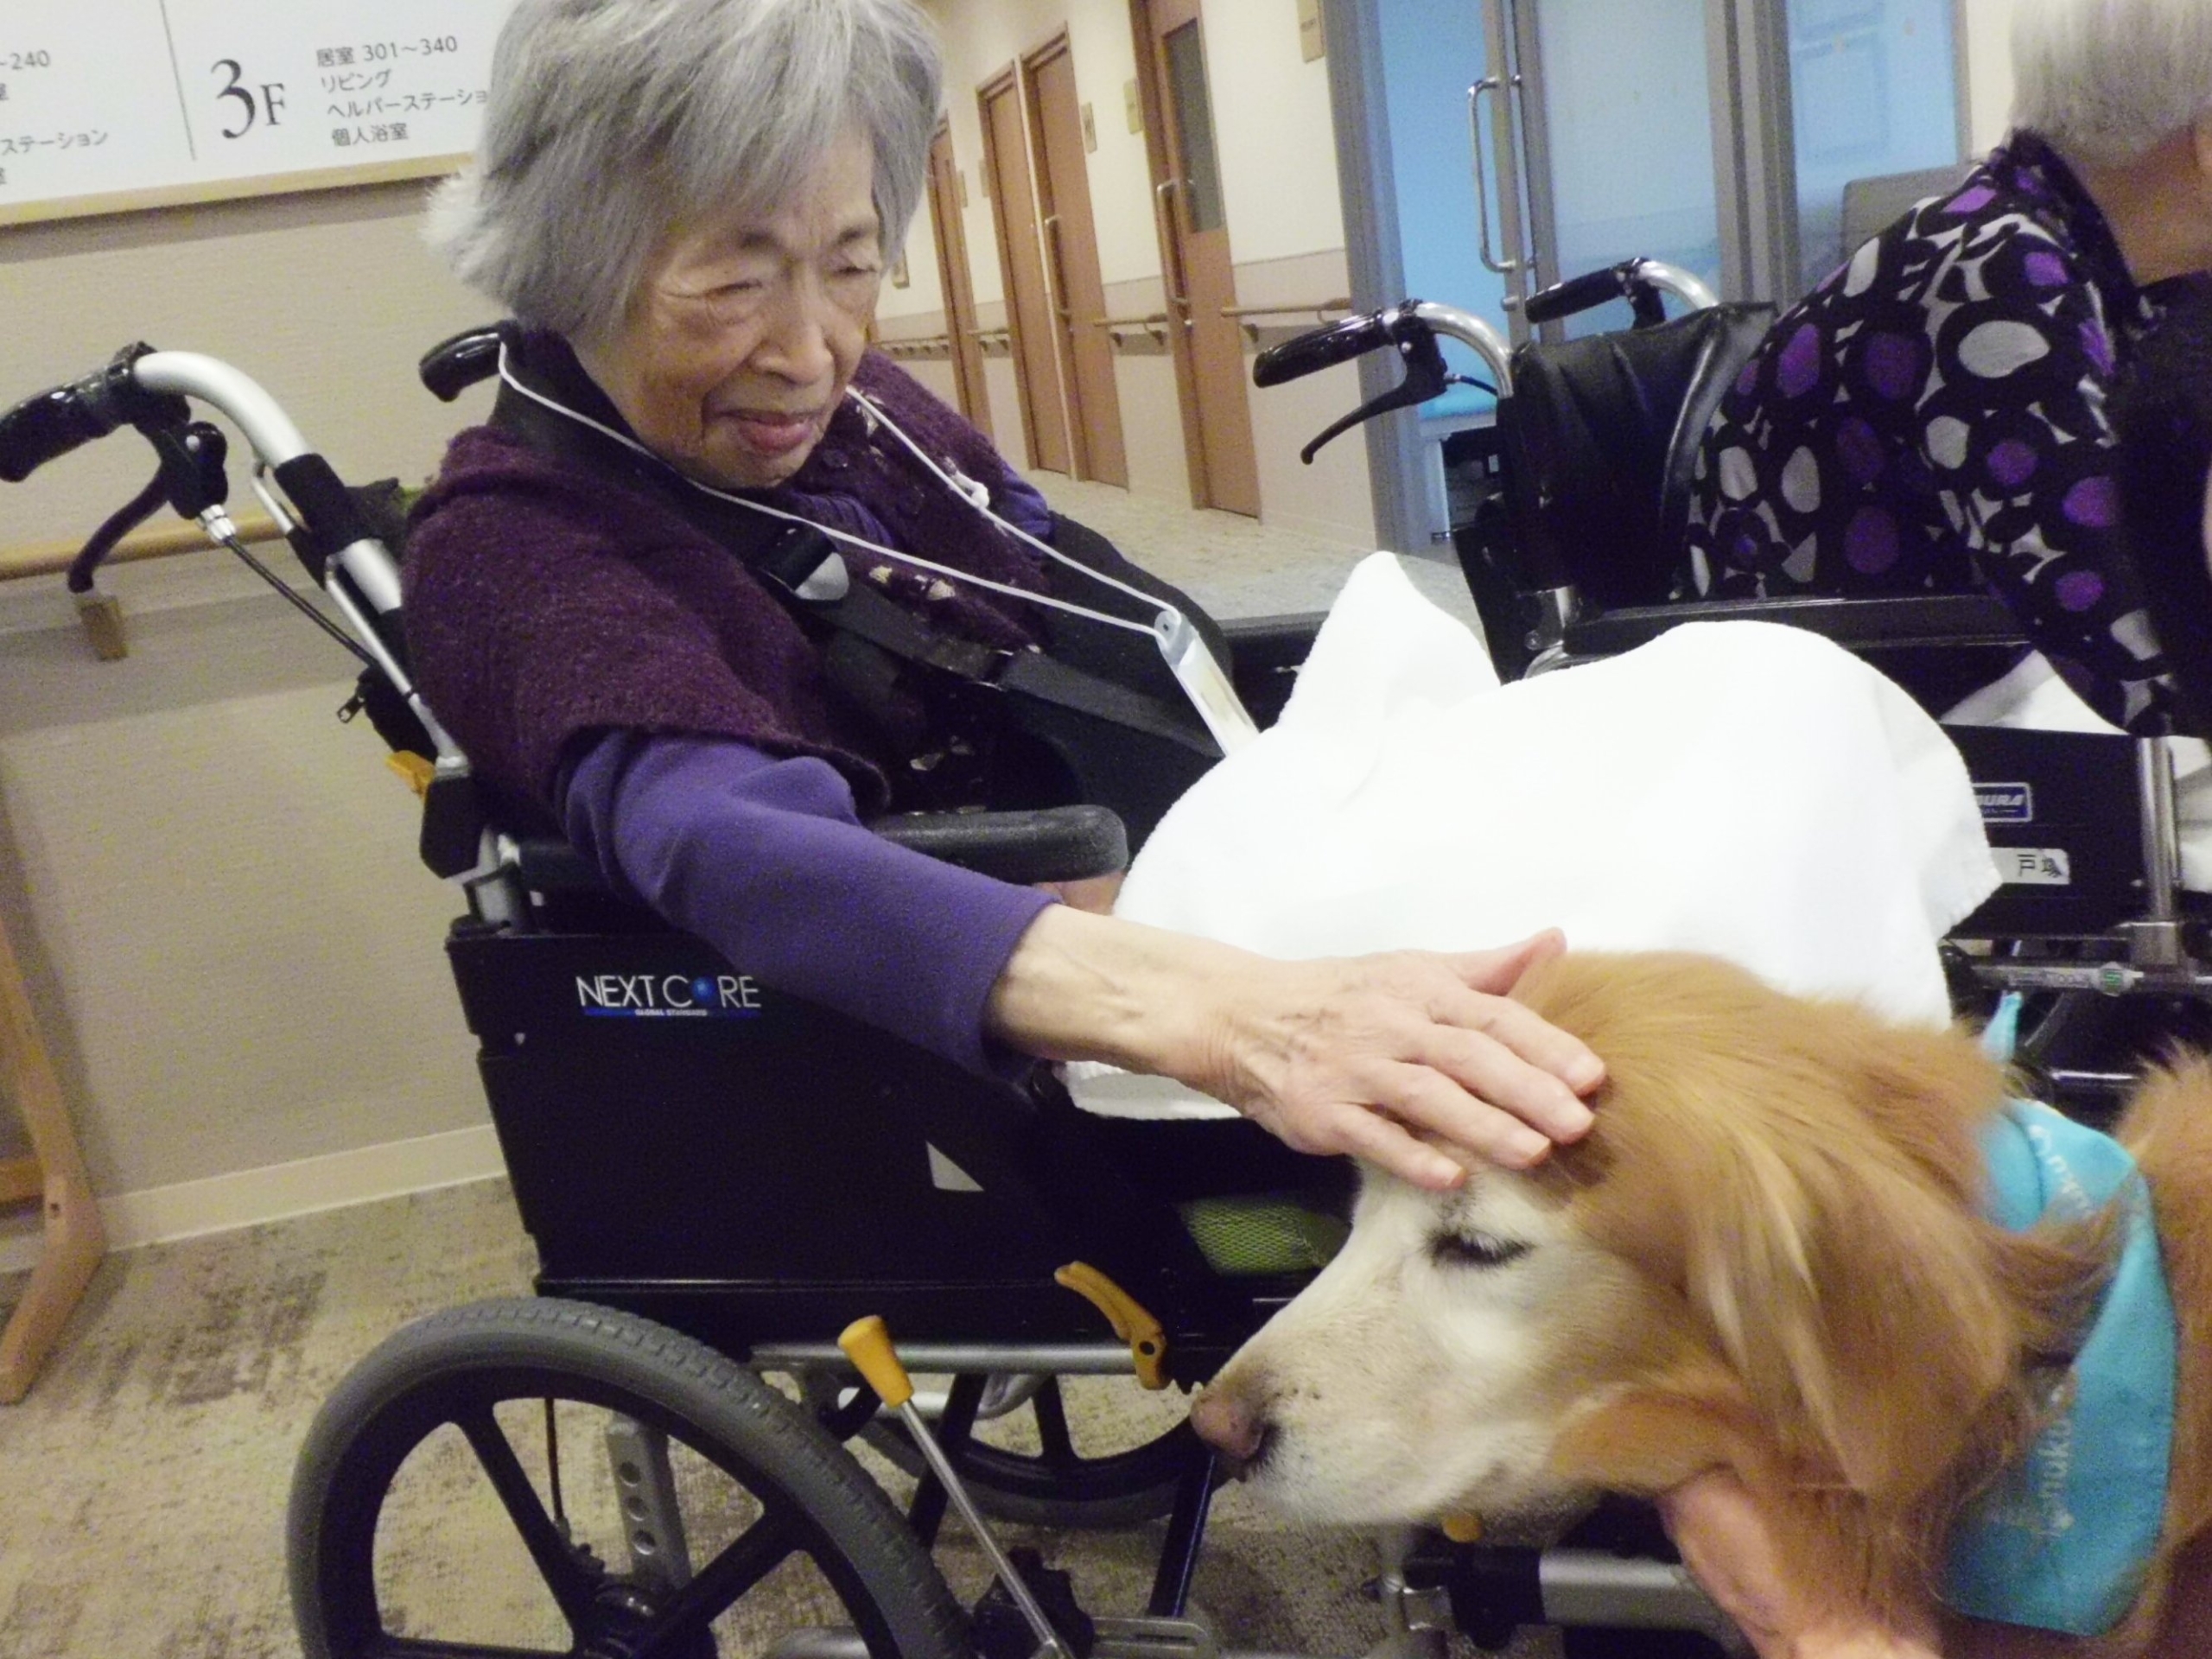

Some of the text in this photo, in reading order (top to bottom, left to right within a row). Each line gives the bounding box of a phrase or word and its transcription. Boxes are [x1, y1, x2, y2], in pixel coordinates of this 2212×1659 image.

[321, 68, 391, 92] リビング
[210, 59, 285, 139] 3F
[331, 123, 409, 147] 個人浴室
